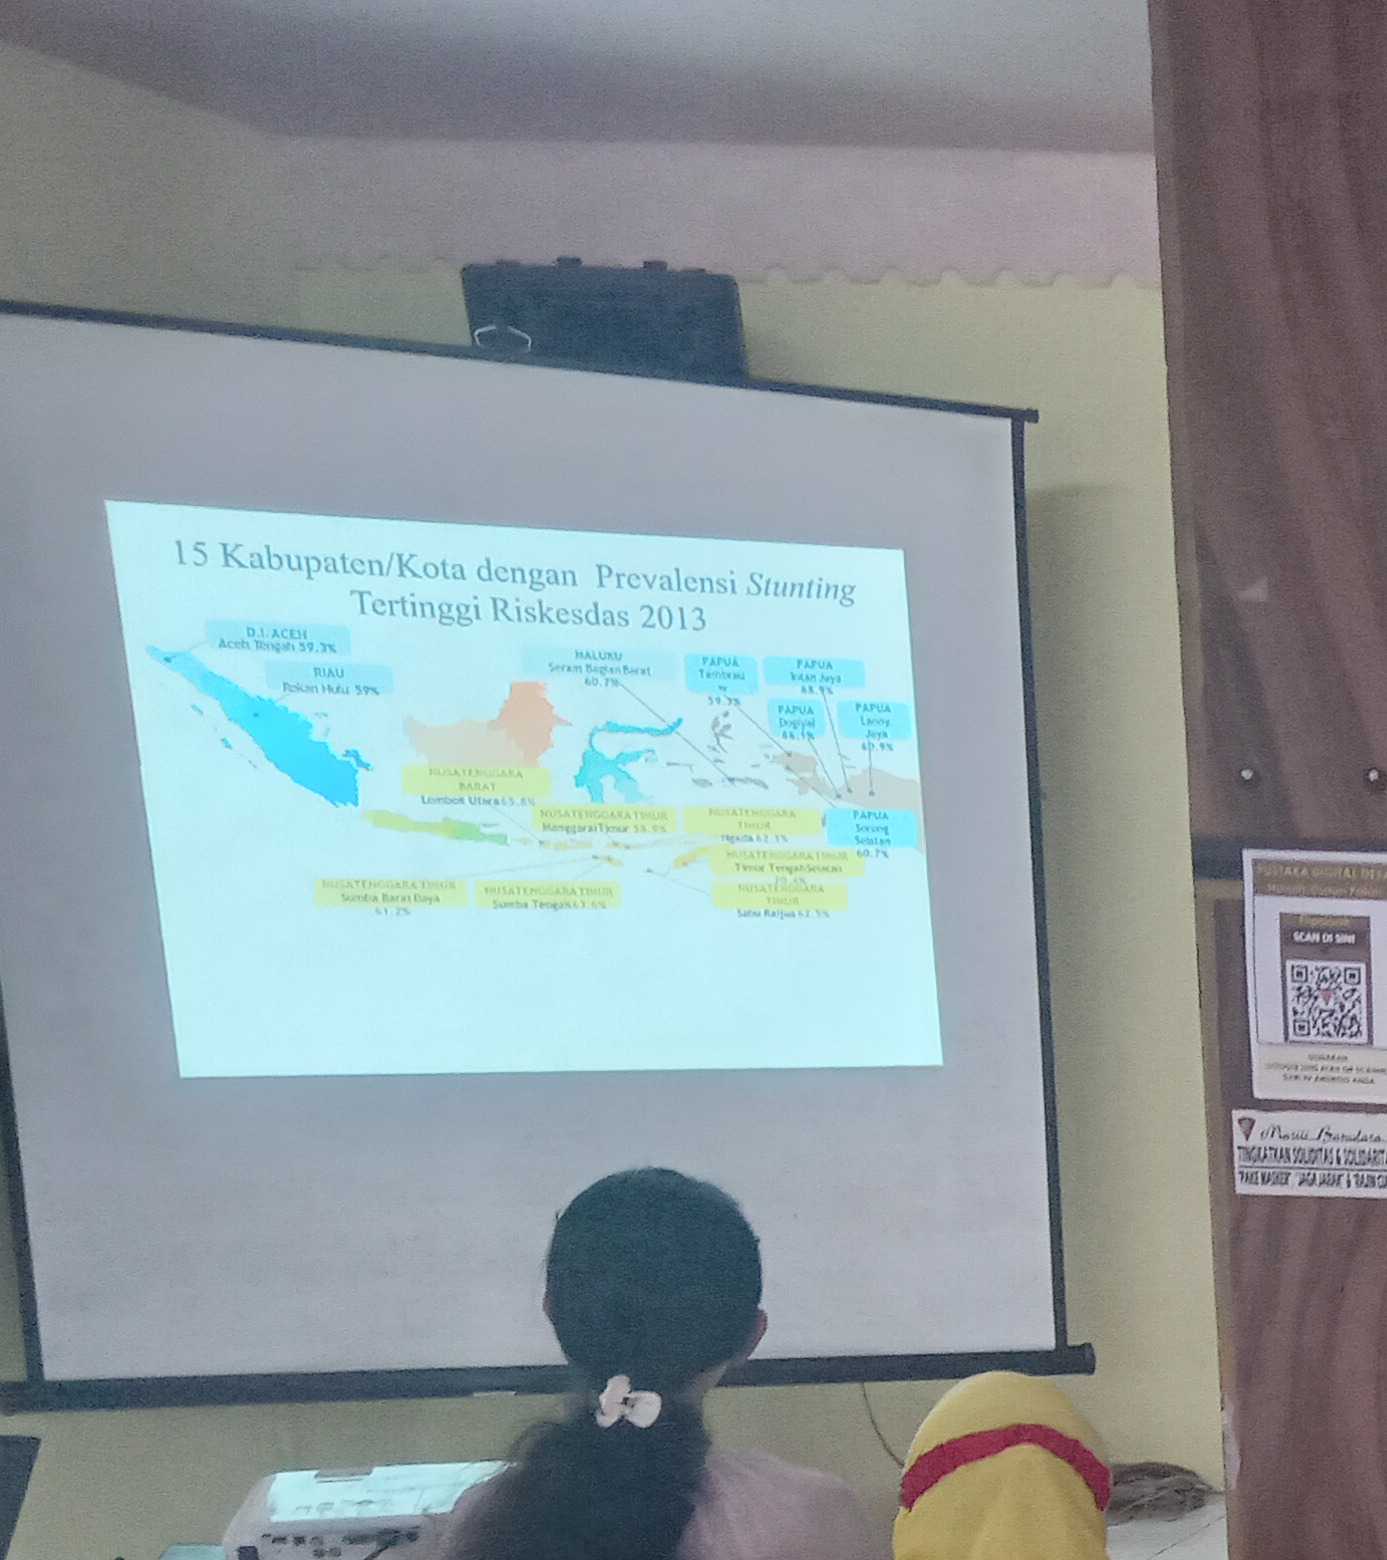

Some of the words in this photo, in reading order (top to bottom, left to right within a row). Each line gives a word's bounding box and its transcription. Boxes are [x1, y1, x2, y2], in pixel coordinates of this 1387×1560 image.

[174, 539, 208, 567] 15
[218, 542, 467, 581] Kabupaten/Kota
[477, 557, 579, 592] dengan
[595, 563, 737, 596] Prevalensi
[746, 571, 856, 608] Stunting
[350, 589, 481, 627] Tertinggi
[490, 595, 630, 628] Riskesdas
[640, 604, 707, 632] 2013
[271, 627, 308, 640] ACEH
[702, 656, 740, 667] PAPUA
[797, 659, 833, 670] PAPUA
[313, 667, 345, 678] RIAU
[778, 705, 814, 715] PAPUA
[855, 703, 891, 713] PAPUA
[853, 811, 889, 821] PAPUA
